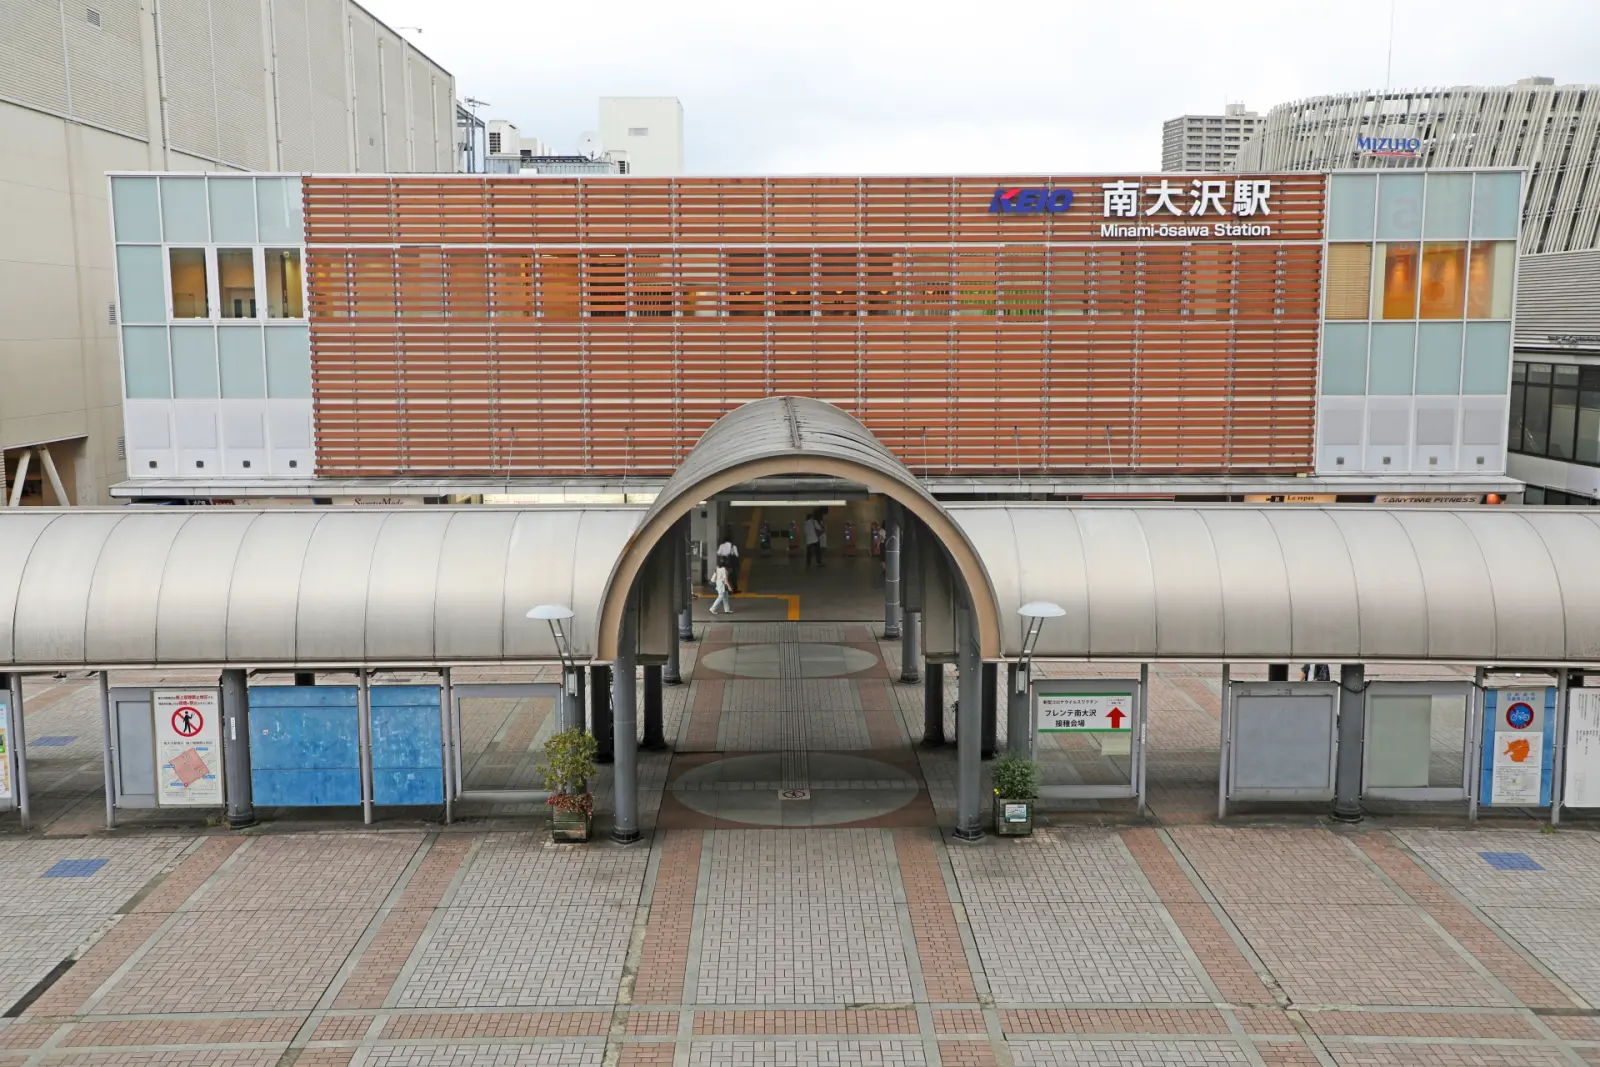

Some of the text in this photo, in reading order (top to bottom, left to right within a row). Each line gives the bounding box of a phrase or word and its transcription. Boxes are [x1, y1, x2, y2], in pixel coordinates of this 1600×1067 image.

[1356, 136, 1421, 151] MIZUHO
[988, 188, 1074, 213] KEIO
[1101, 179, 1271, 217] 南大沢駅
[1213, 223, 1271, 237] Station
[1044, 709, 1097, 717] フレンテ南大沢
[1055, 719, 1086, 728] 接種会場
